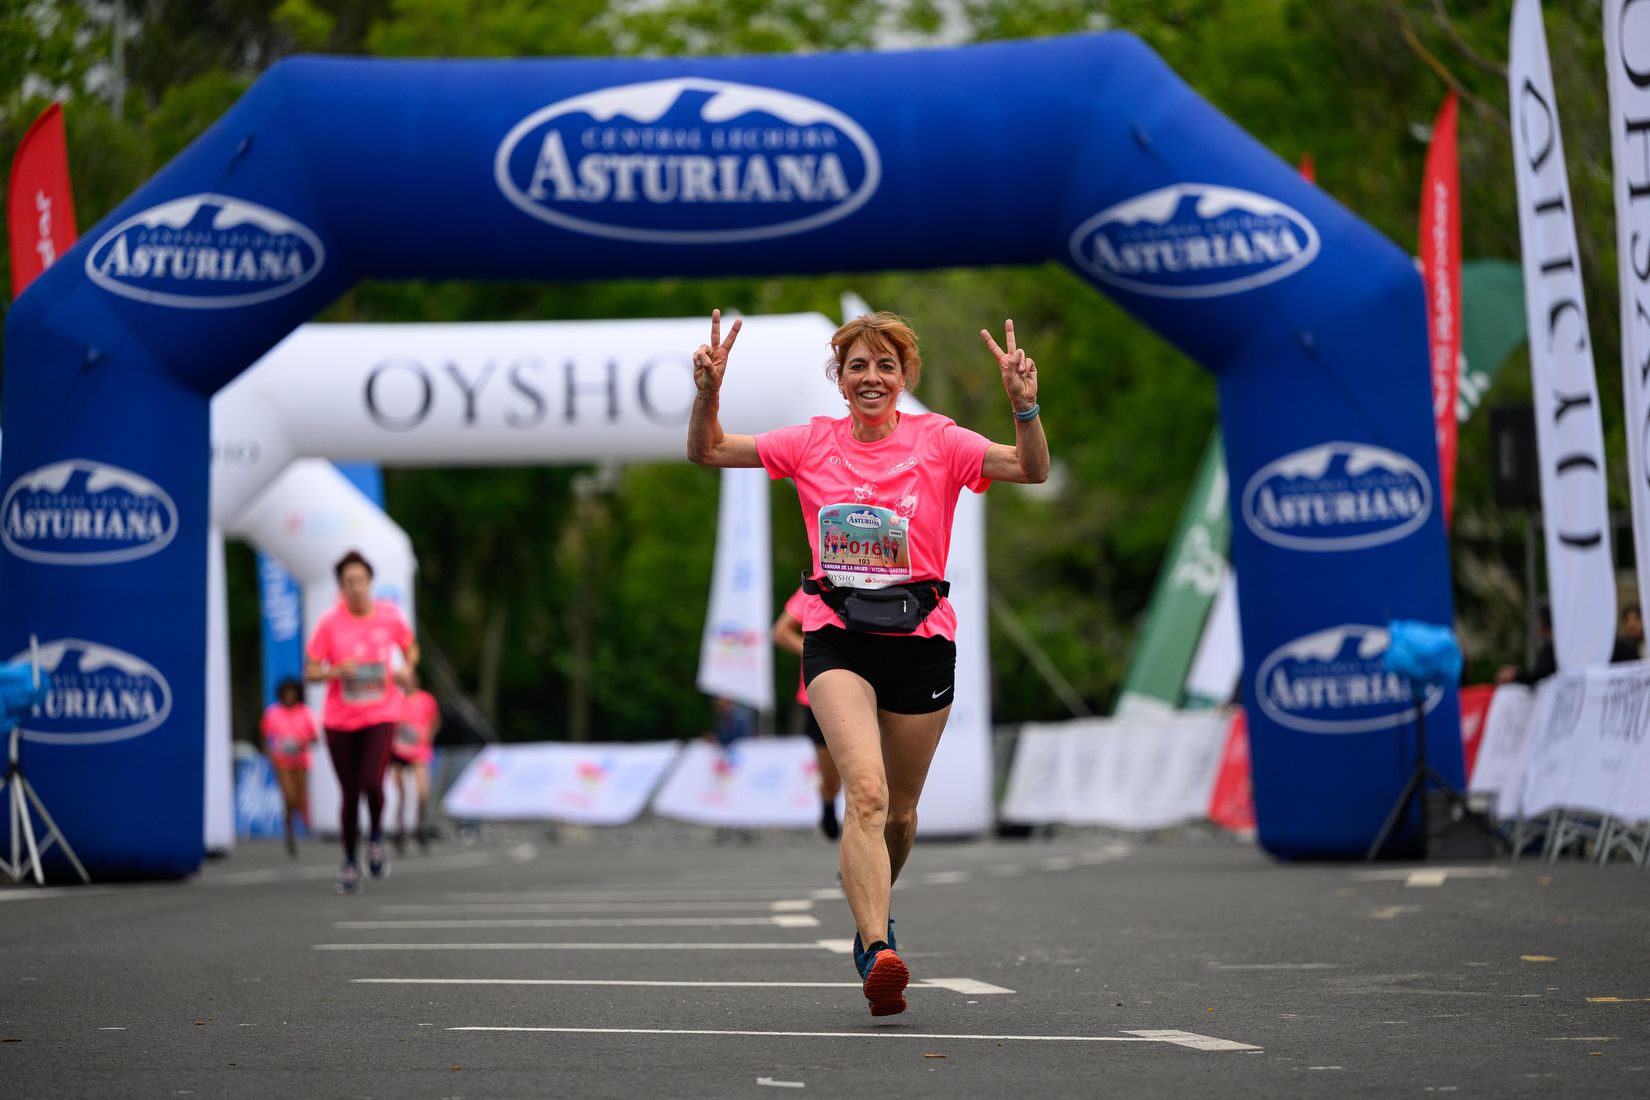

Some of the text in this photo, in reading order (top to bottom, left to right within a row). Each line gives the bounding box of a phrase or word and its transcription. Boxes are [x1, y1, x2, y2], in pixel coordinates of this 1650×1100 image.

[529, 129, 851, 203] ASTURIANA
[101, 232, 305, 282] ASTURIANA
[1093, 227, 1301, 275] ASTURIANA
[363, 354, 694, 434] OYSHO
[7, 500, 165, 542] ASTURIANA
[1256, 485, 1423, 528] ASTURIANA
[848, 540, 882, 556] 016
[1270, 667, 1411, 710] ASTURIA
